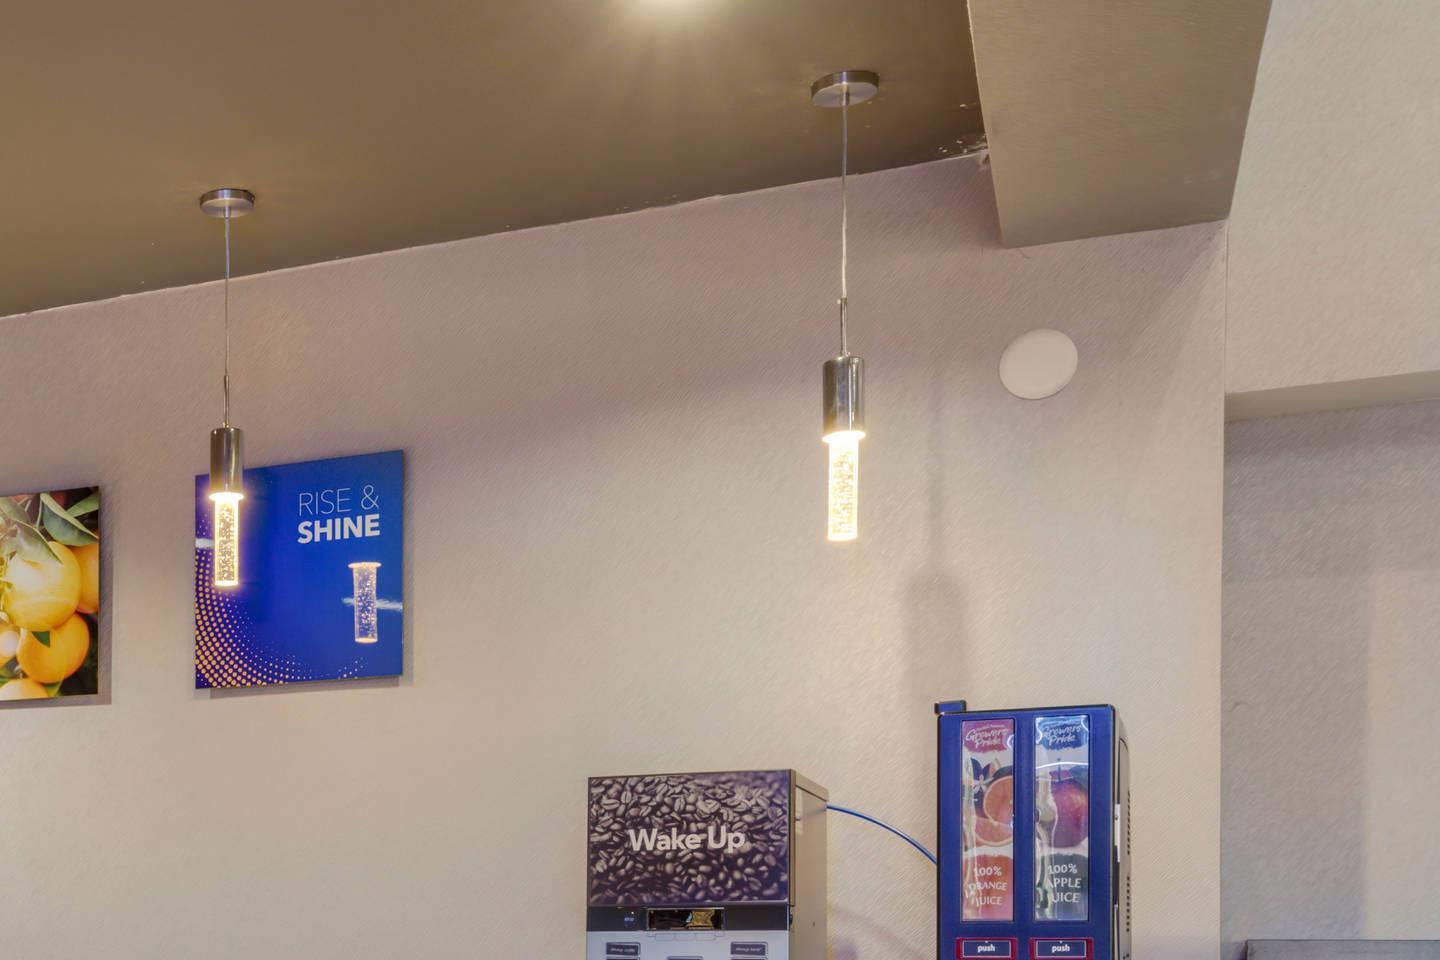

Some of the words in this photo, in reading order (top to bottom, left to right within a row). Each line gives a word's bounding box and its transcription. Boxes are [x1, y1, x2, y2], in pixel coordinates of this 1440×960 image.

[298, 487, 352, 517] RISE
[360, 484, 380, 511] &
[297, 513, 381, 545] SHINE
[628, 826, 702, 852] Wake
[707, 824, 746, 854] Up
[974, 865, 1003, 877] 100%
[1047, 863, 1078, 875] 100%
[977, 944, 996, 954] push
[1051, 944, 1071, 954] push
